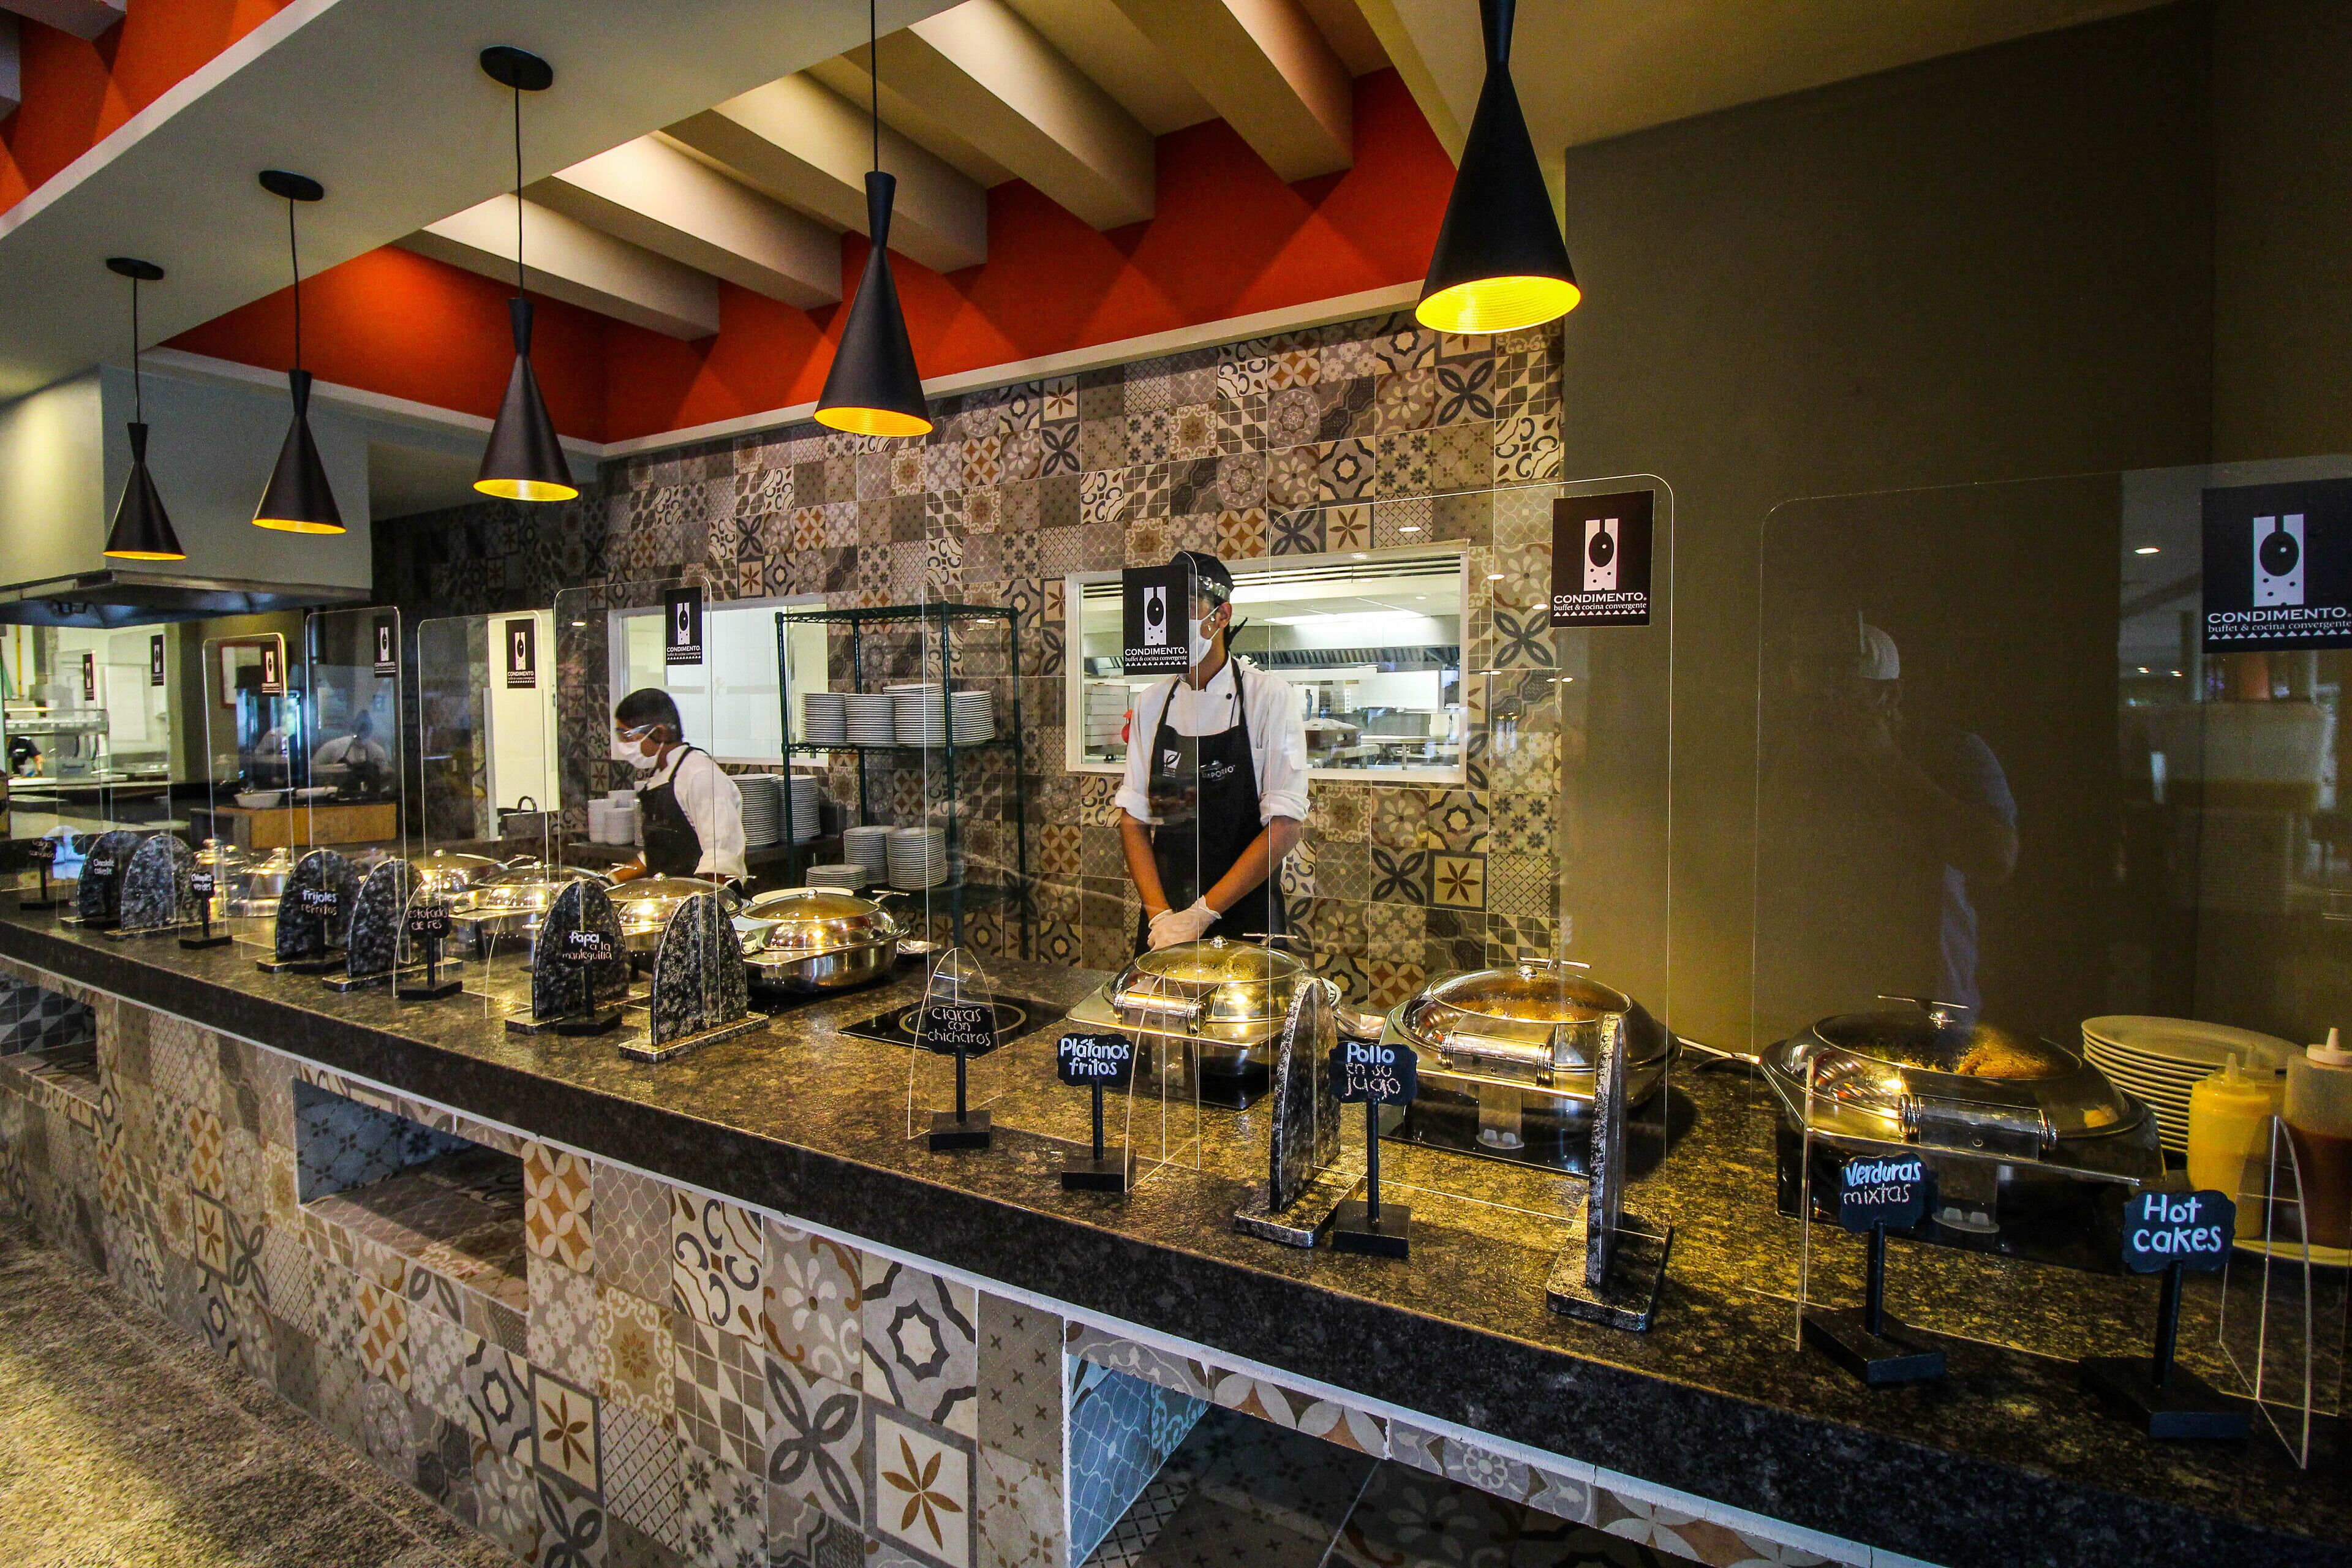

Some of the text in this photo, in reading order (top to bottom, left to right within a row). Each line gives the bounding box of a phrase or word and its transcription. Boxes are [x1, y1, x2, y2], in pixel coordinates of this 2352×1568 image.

[2208, 624, 2237, 633] buffet
[2288, 620, 2352, 631] convergente
[411, 921, 424, 930] de
[569, 931, 600, 947] Papa
[601, 941, 611, 952] la
[562, 948, 612, 960] mantequilla
[948, 1020, 971, 1032] con
[927, 1028, 991, 1047] chicharos
[1060, 1038, 1129, 1060] Plátanos
[1347, 1042, 1395, 1064] Pollo
[1069, 1057, 1117, 1076] fritos
[1371, 1064, 1392, 1077] su
[1345, 1073, 1401, 1100] jugo
[1845, 1161, 1922, 1187] Verduras
[1844, 1183, 1911, 1205] mixtas
[2143, 1194, 2203, 1224] Hot
[2133, 1226, 2222, 1254] cakes
